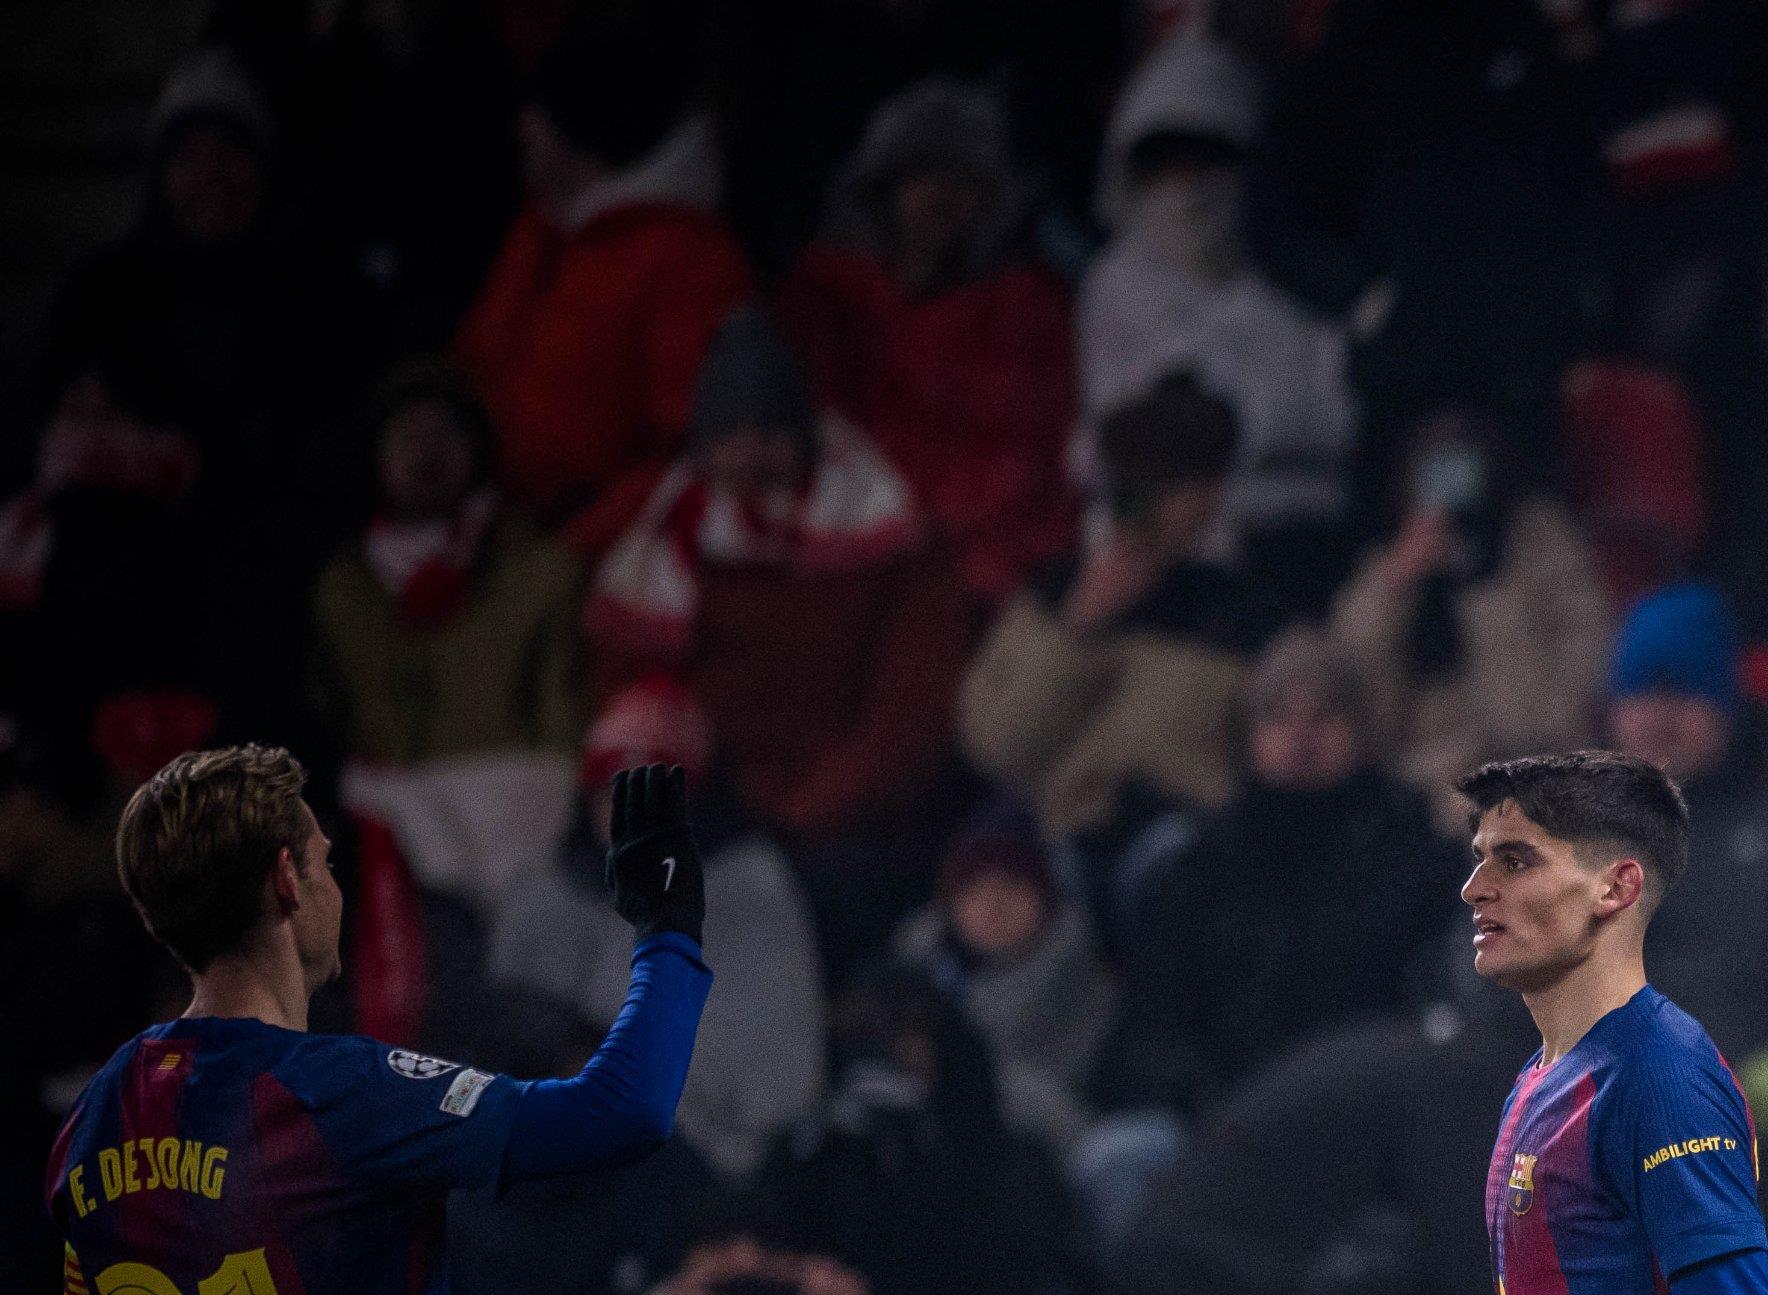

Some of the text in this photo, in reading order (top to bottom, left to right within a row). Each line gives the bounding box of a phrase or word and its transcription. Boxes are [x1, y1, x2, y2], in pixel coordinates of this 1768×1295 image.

[1642, 1137, 1736, 1173] AMBILIGHT tv
[68, 1163, 98, 1219] F.
